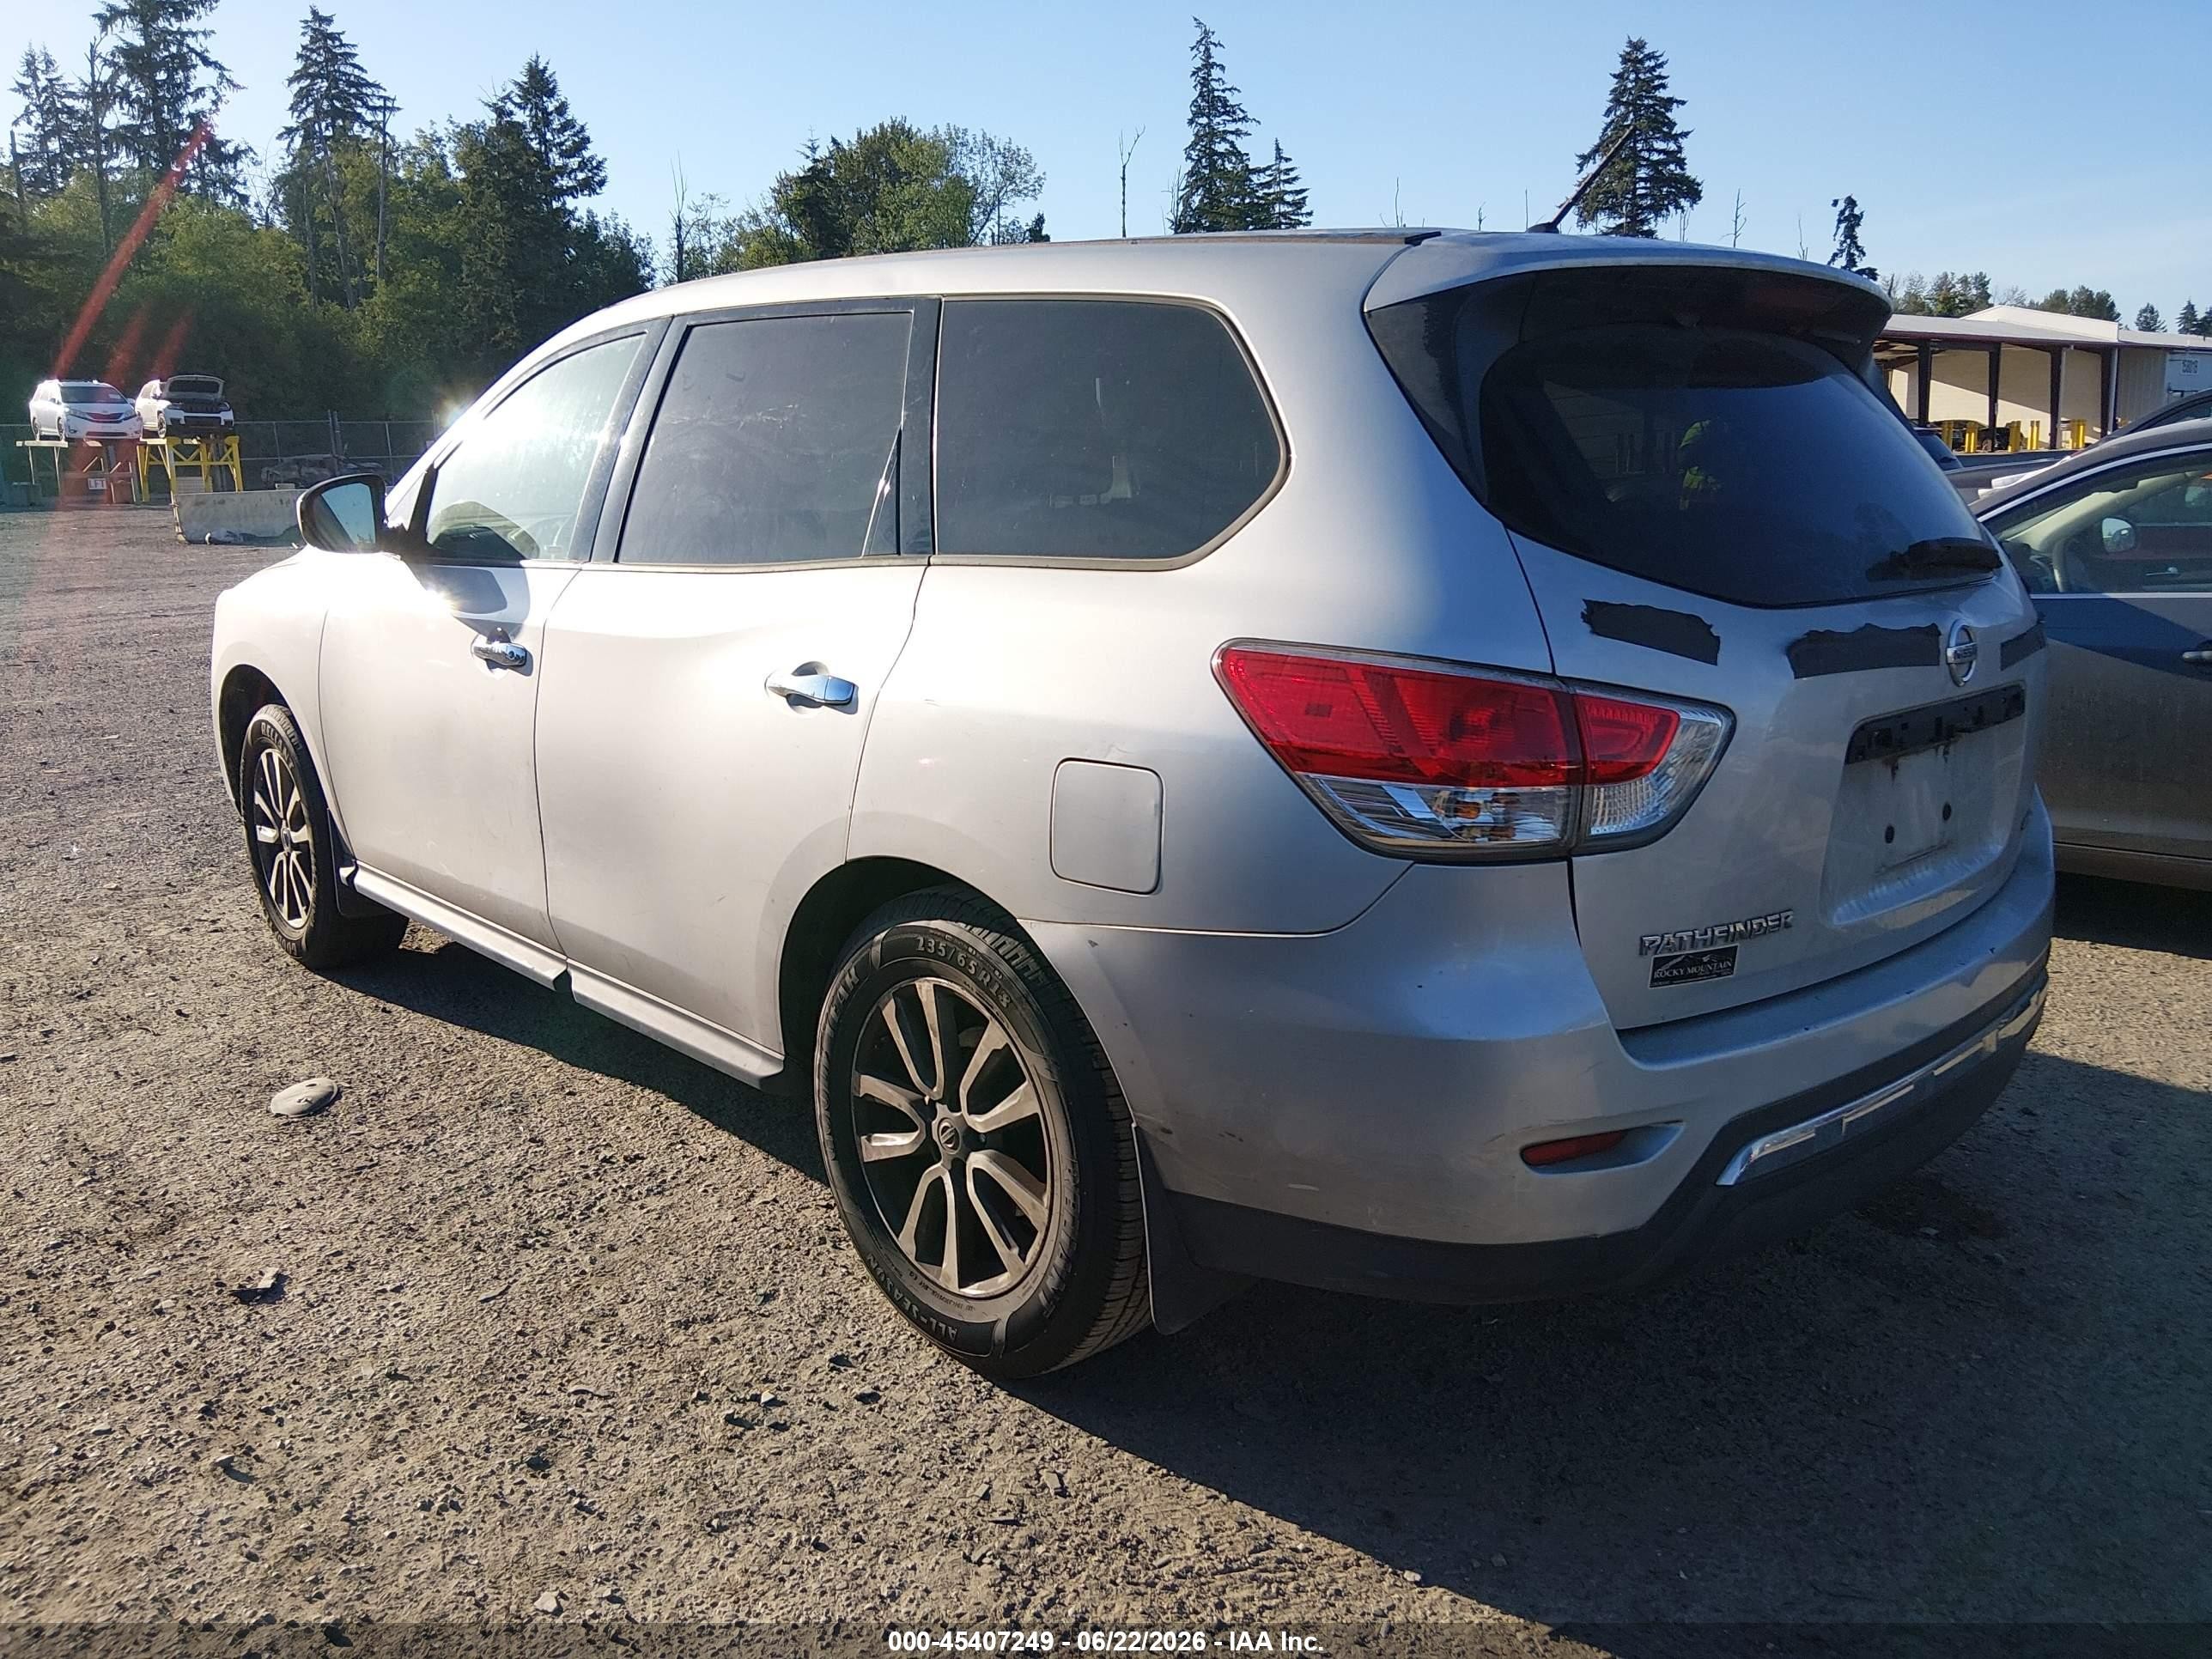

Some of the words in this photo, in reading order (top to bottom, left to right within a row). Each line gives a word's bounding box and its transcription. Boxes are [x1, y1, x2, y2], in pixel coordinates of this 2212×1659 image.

[1639, 908, 1794, 955] PATHFINDER
[915, 935, 1011, 1008] 235/65R18
[1654, 968, 1685, 979] ROCKY
[1686, 961, 1733, 975] MOUNTAIN
[866, 1254, 959, 1341] ALL-SEASON
